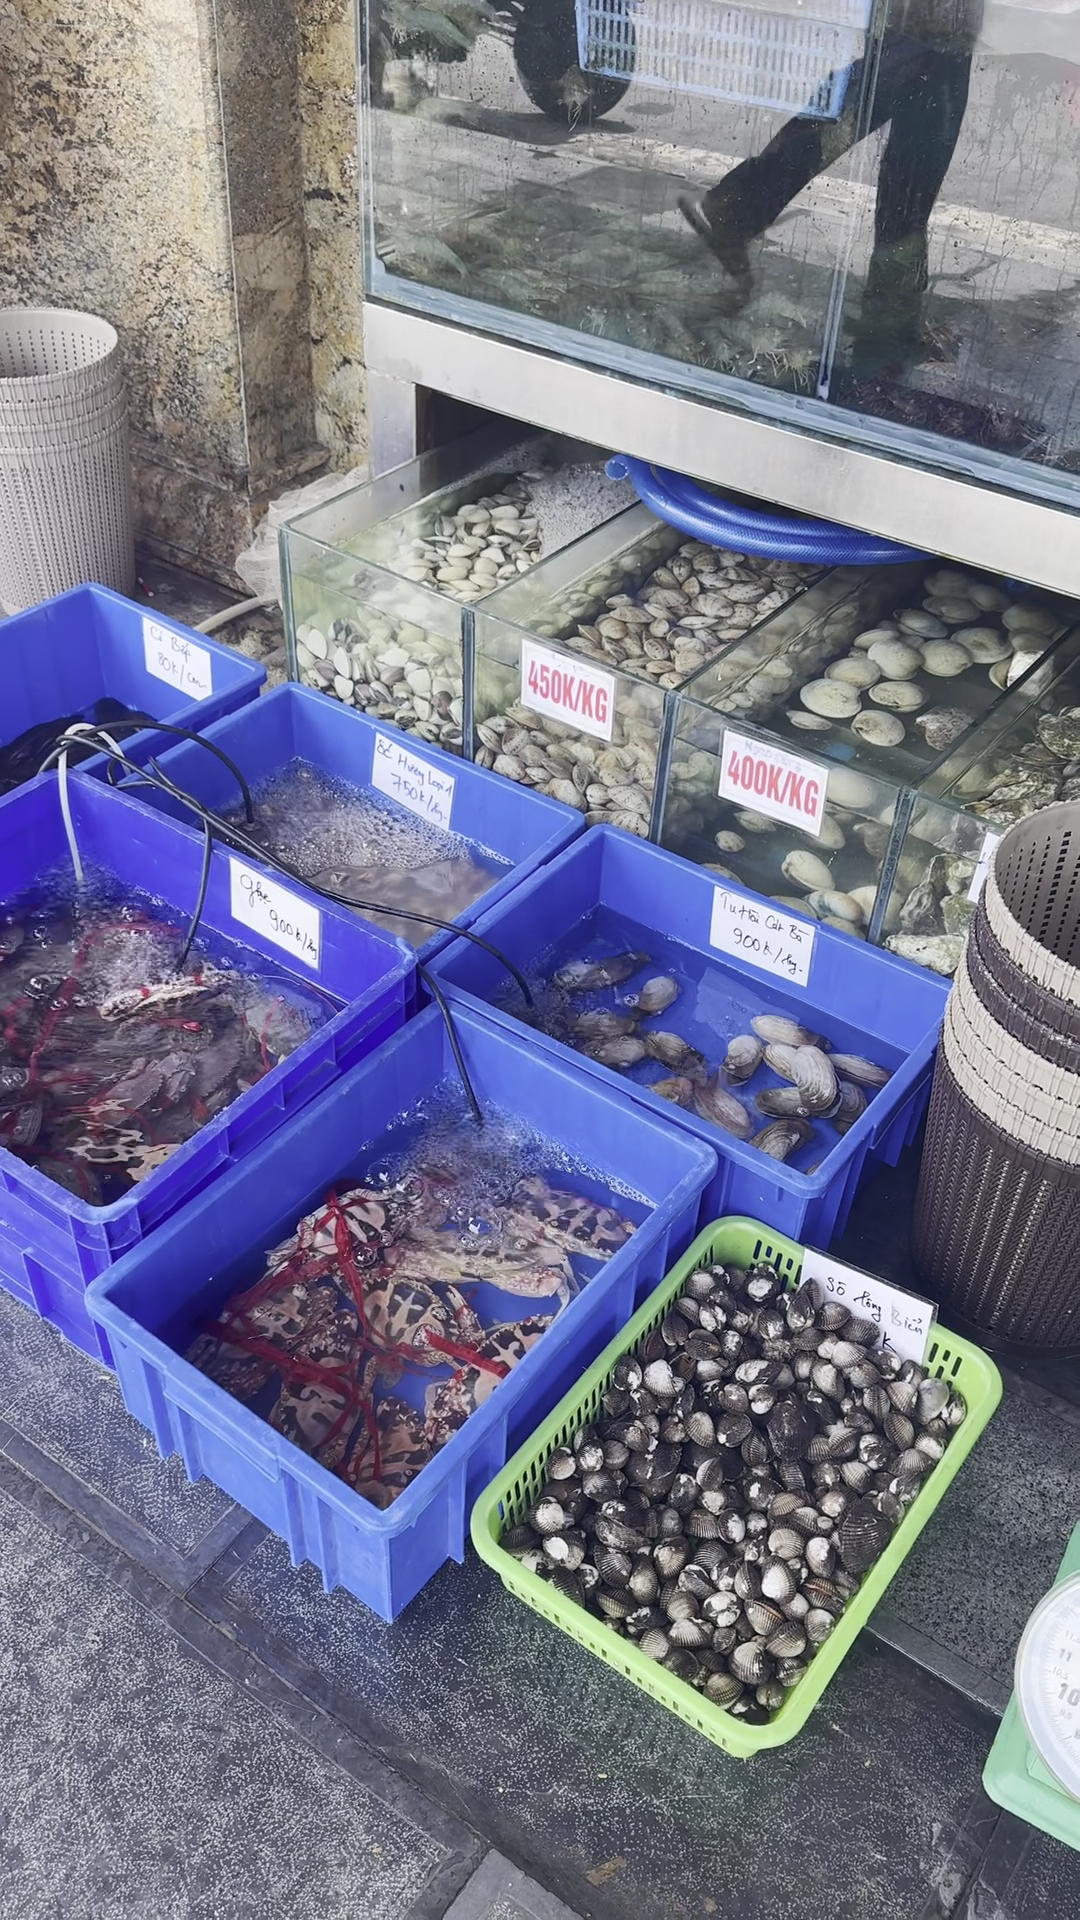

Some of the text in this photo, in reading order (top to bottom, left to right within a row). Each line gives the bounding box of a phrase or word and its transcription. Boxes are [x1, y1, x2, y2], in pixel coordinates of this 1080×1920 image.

[527, 660, 608, 724] 450K/KG
[727, 750, 820, 818] 400K/KG
[1059, 1647, 1073, 1663] 11
[1051, 1666, 1070, 1681] 10.5
[1058, 1682, 1080, 1707] 10
